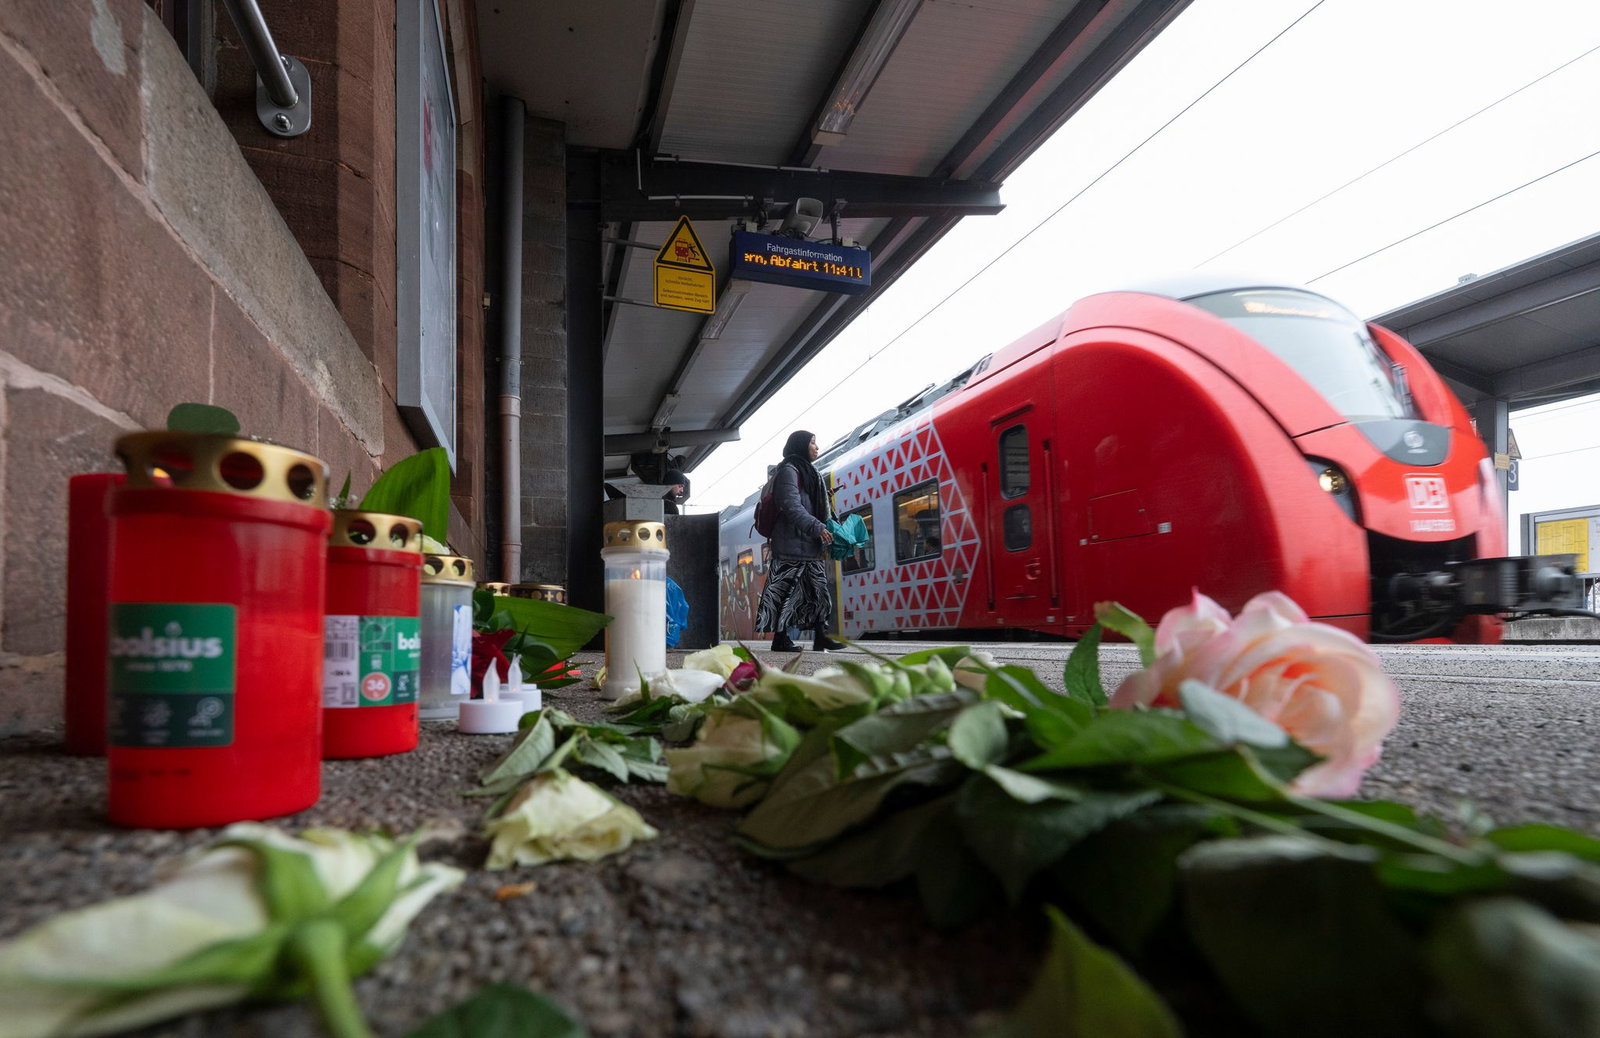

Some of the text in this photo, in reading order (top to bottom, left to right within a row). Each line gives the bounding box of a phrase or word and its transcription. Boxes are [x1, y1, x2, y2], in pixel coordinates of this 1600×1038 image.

[767, 243, 843, 262] Fahrgastinformation
[770, 254, 819, 272] Abfahrt
[823, 262, 853, 277] 11:41
[1508, 461, 1517, 483] 3
[367, 679, 386, 691] 36
